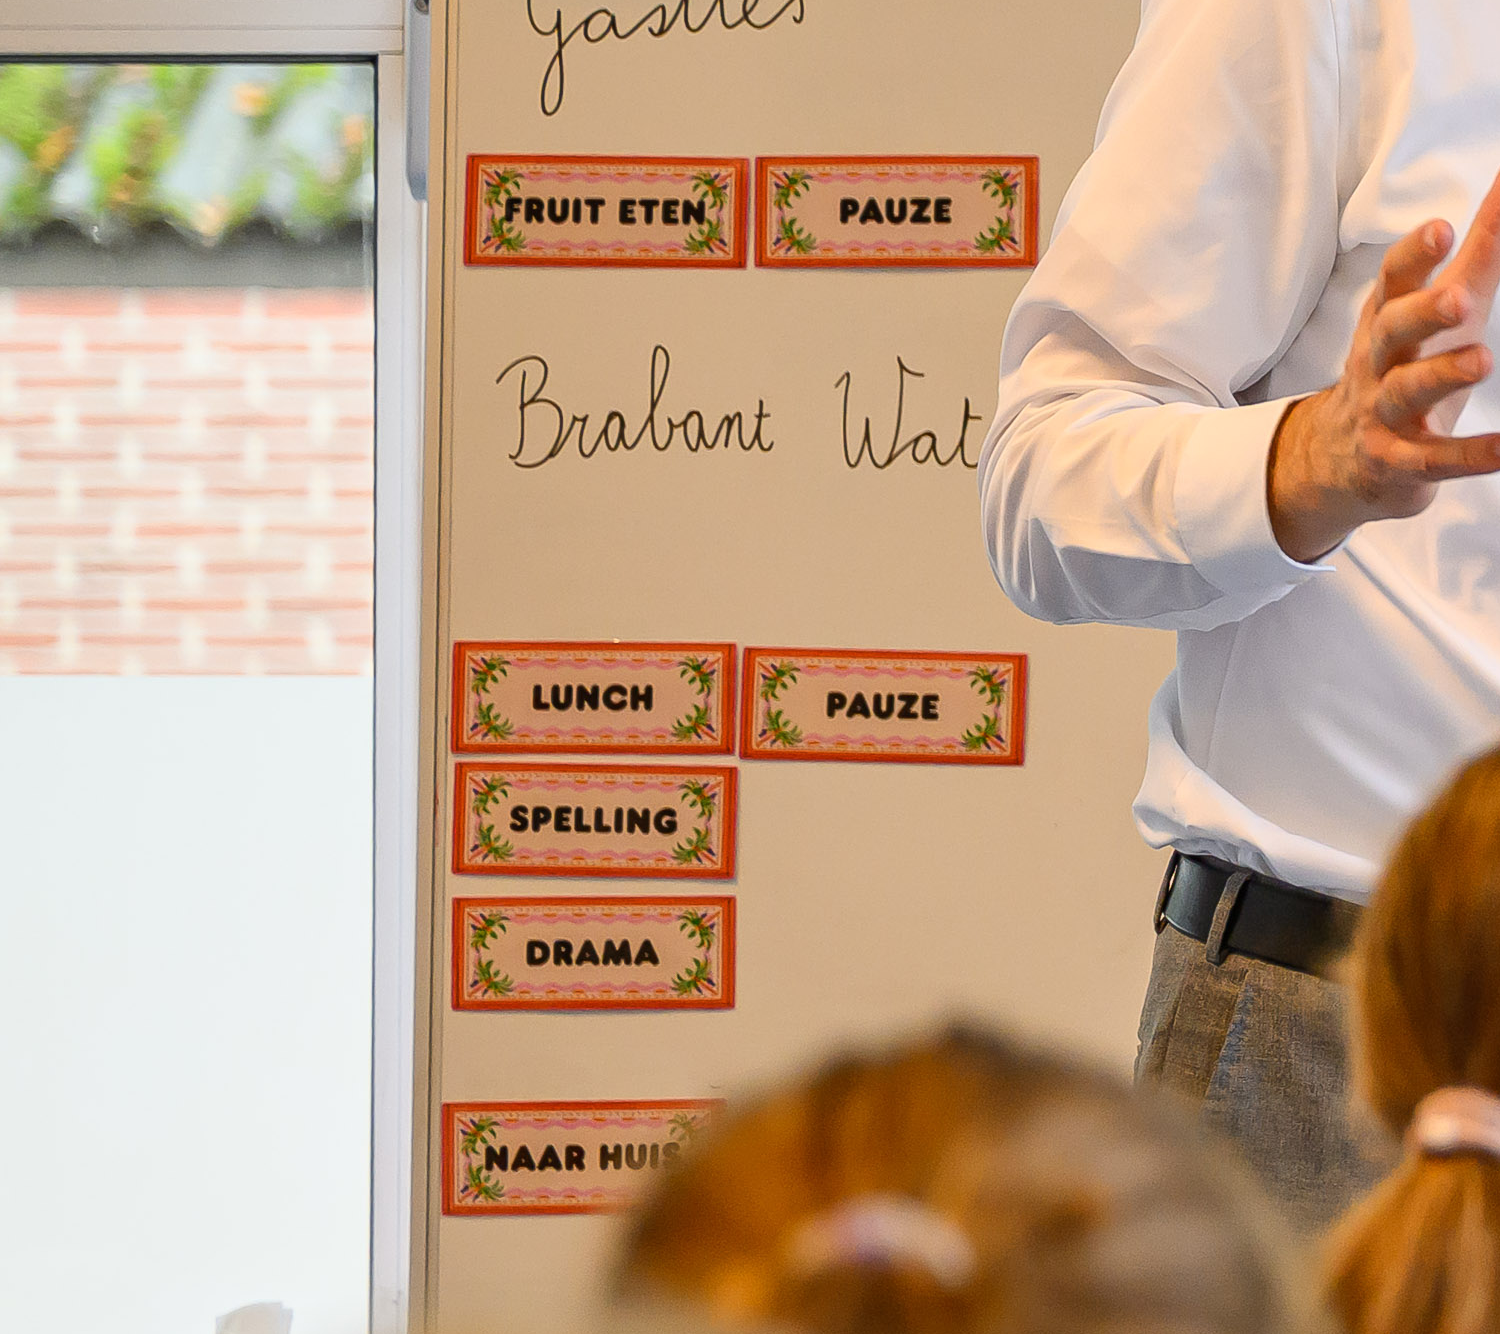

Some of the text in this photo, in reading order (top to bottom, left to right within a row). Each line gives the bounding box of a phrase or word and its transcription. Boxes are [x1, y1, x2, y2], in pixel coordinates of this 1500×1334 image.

[503, 195, 707, 227] FRUIT ETEN
[838, 196, 954, 226] PAUZE
[494, 343, 984, 471] Brabant Wat
[531, 683, 655, 713] LUNCH
[825, 691, 941, 722] PAUZE
[508, 804, 679, 836] SPELLING
[525, 938, 661, 968] DRAMA
[484, 1143, 586, 1173] NAAR
